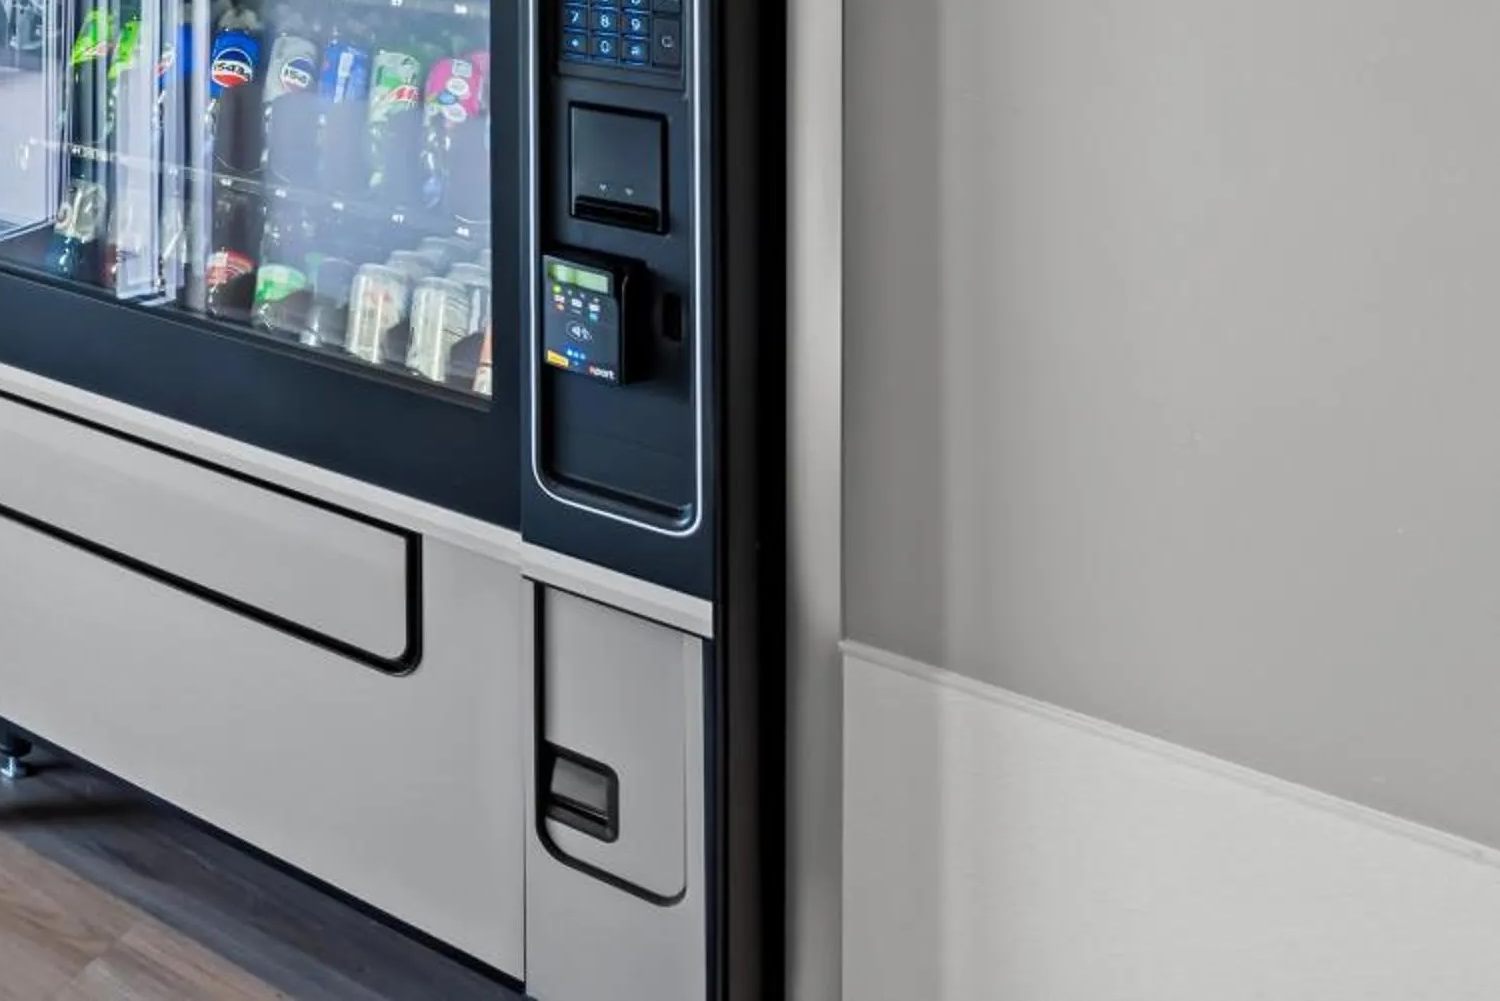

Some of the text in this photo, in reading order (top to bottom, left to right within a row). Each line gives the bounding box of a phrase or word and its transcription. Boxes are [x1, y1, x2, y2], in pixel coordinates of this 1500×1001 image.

[571, 10, 579, 23] 7
[601, 14, 610, 28] 8
[631, 18, 641, 31] 9
[600, 40, 610, 53] 0
